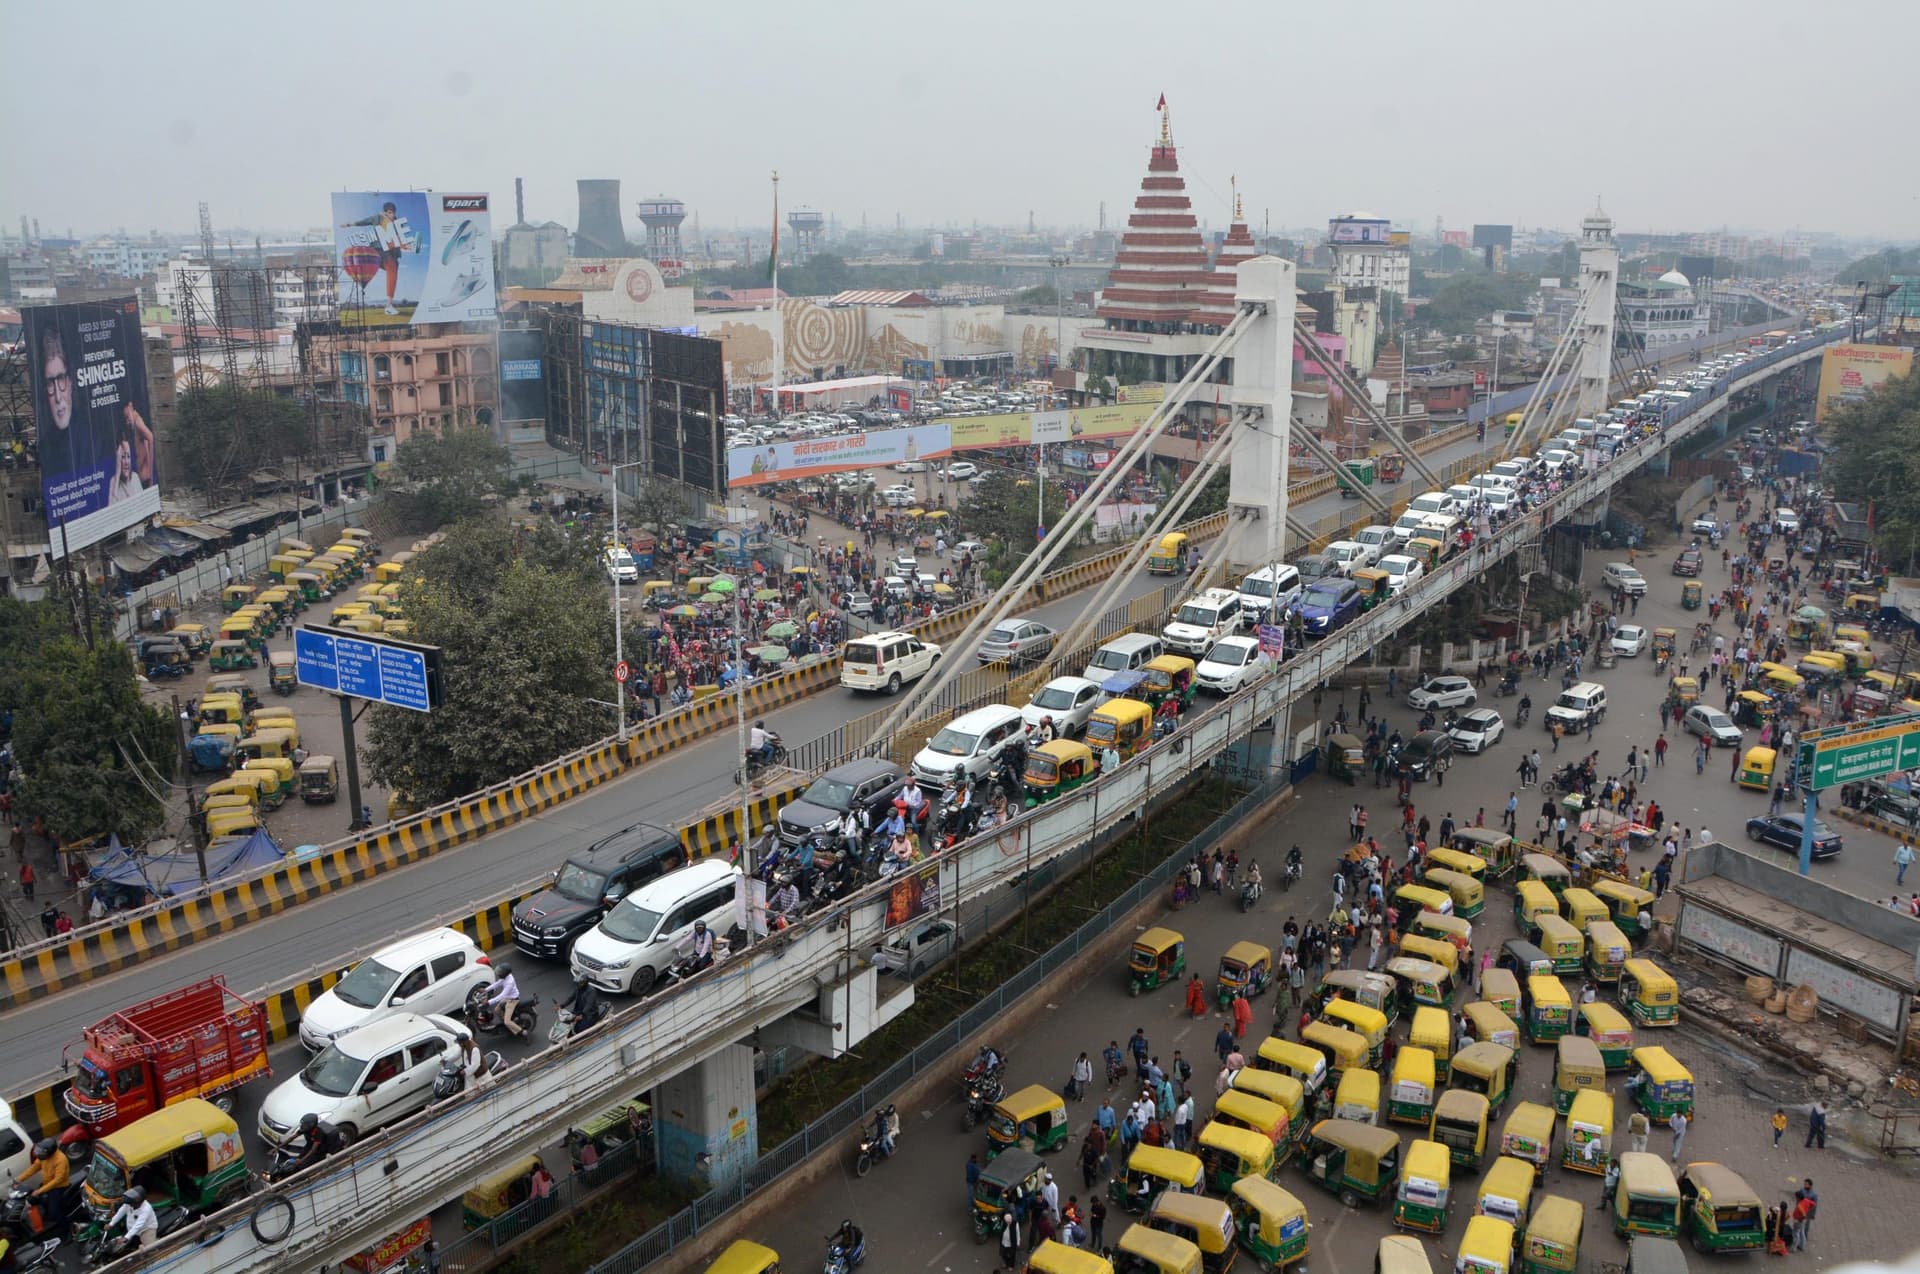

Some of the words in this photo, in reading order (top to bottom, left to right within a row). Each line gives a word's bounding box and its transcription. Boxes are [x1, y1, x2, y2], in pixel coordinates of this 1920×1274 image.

[446, 198, 482, 209] sparx
[78, 322, 92, 333] AGED
[92, 321, 99, 331] 50
[100, 319, 116, 329] YEARS
[84, 348, 115, 363] PREVENTING
[77, 360, 126, 387] SHINGLES
[91, 399, 97, 409] IS
[97, 393, 120, 407] POSSIBLE
[793, 442, 810, 456] मोदी
[811, 440, 837, 454] सरकार
[847, 433, 866, 448] गारंटी
[49, 482, 67, 495] Consult
[67, 480, 78, 491] your
[78, 475, 93, 486] doctor
[93, 471, 105, 481] today
[57, 494, 69, 504] know
[70, 489, 83, 499] about
[83, 483, 101, 496] Shingles
[63, 500, 87, 515] prevention
[298, 656, 318, 666] RAILWAY
[318, 660, 337, 670] STATION
[394, 661, 413, 670] STATION
[1868, 760, 1880, 770] MAIN
[1880, 758, 1893, 768] ROAD
